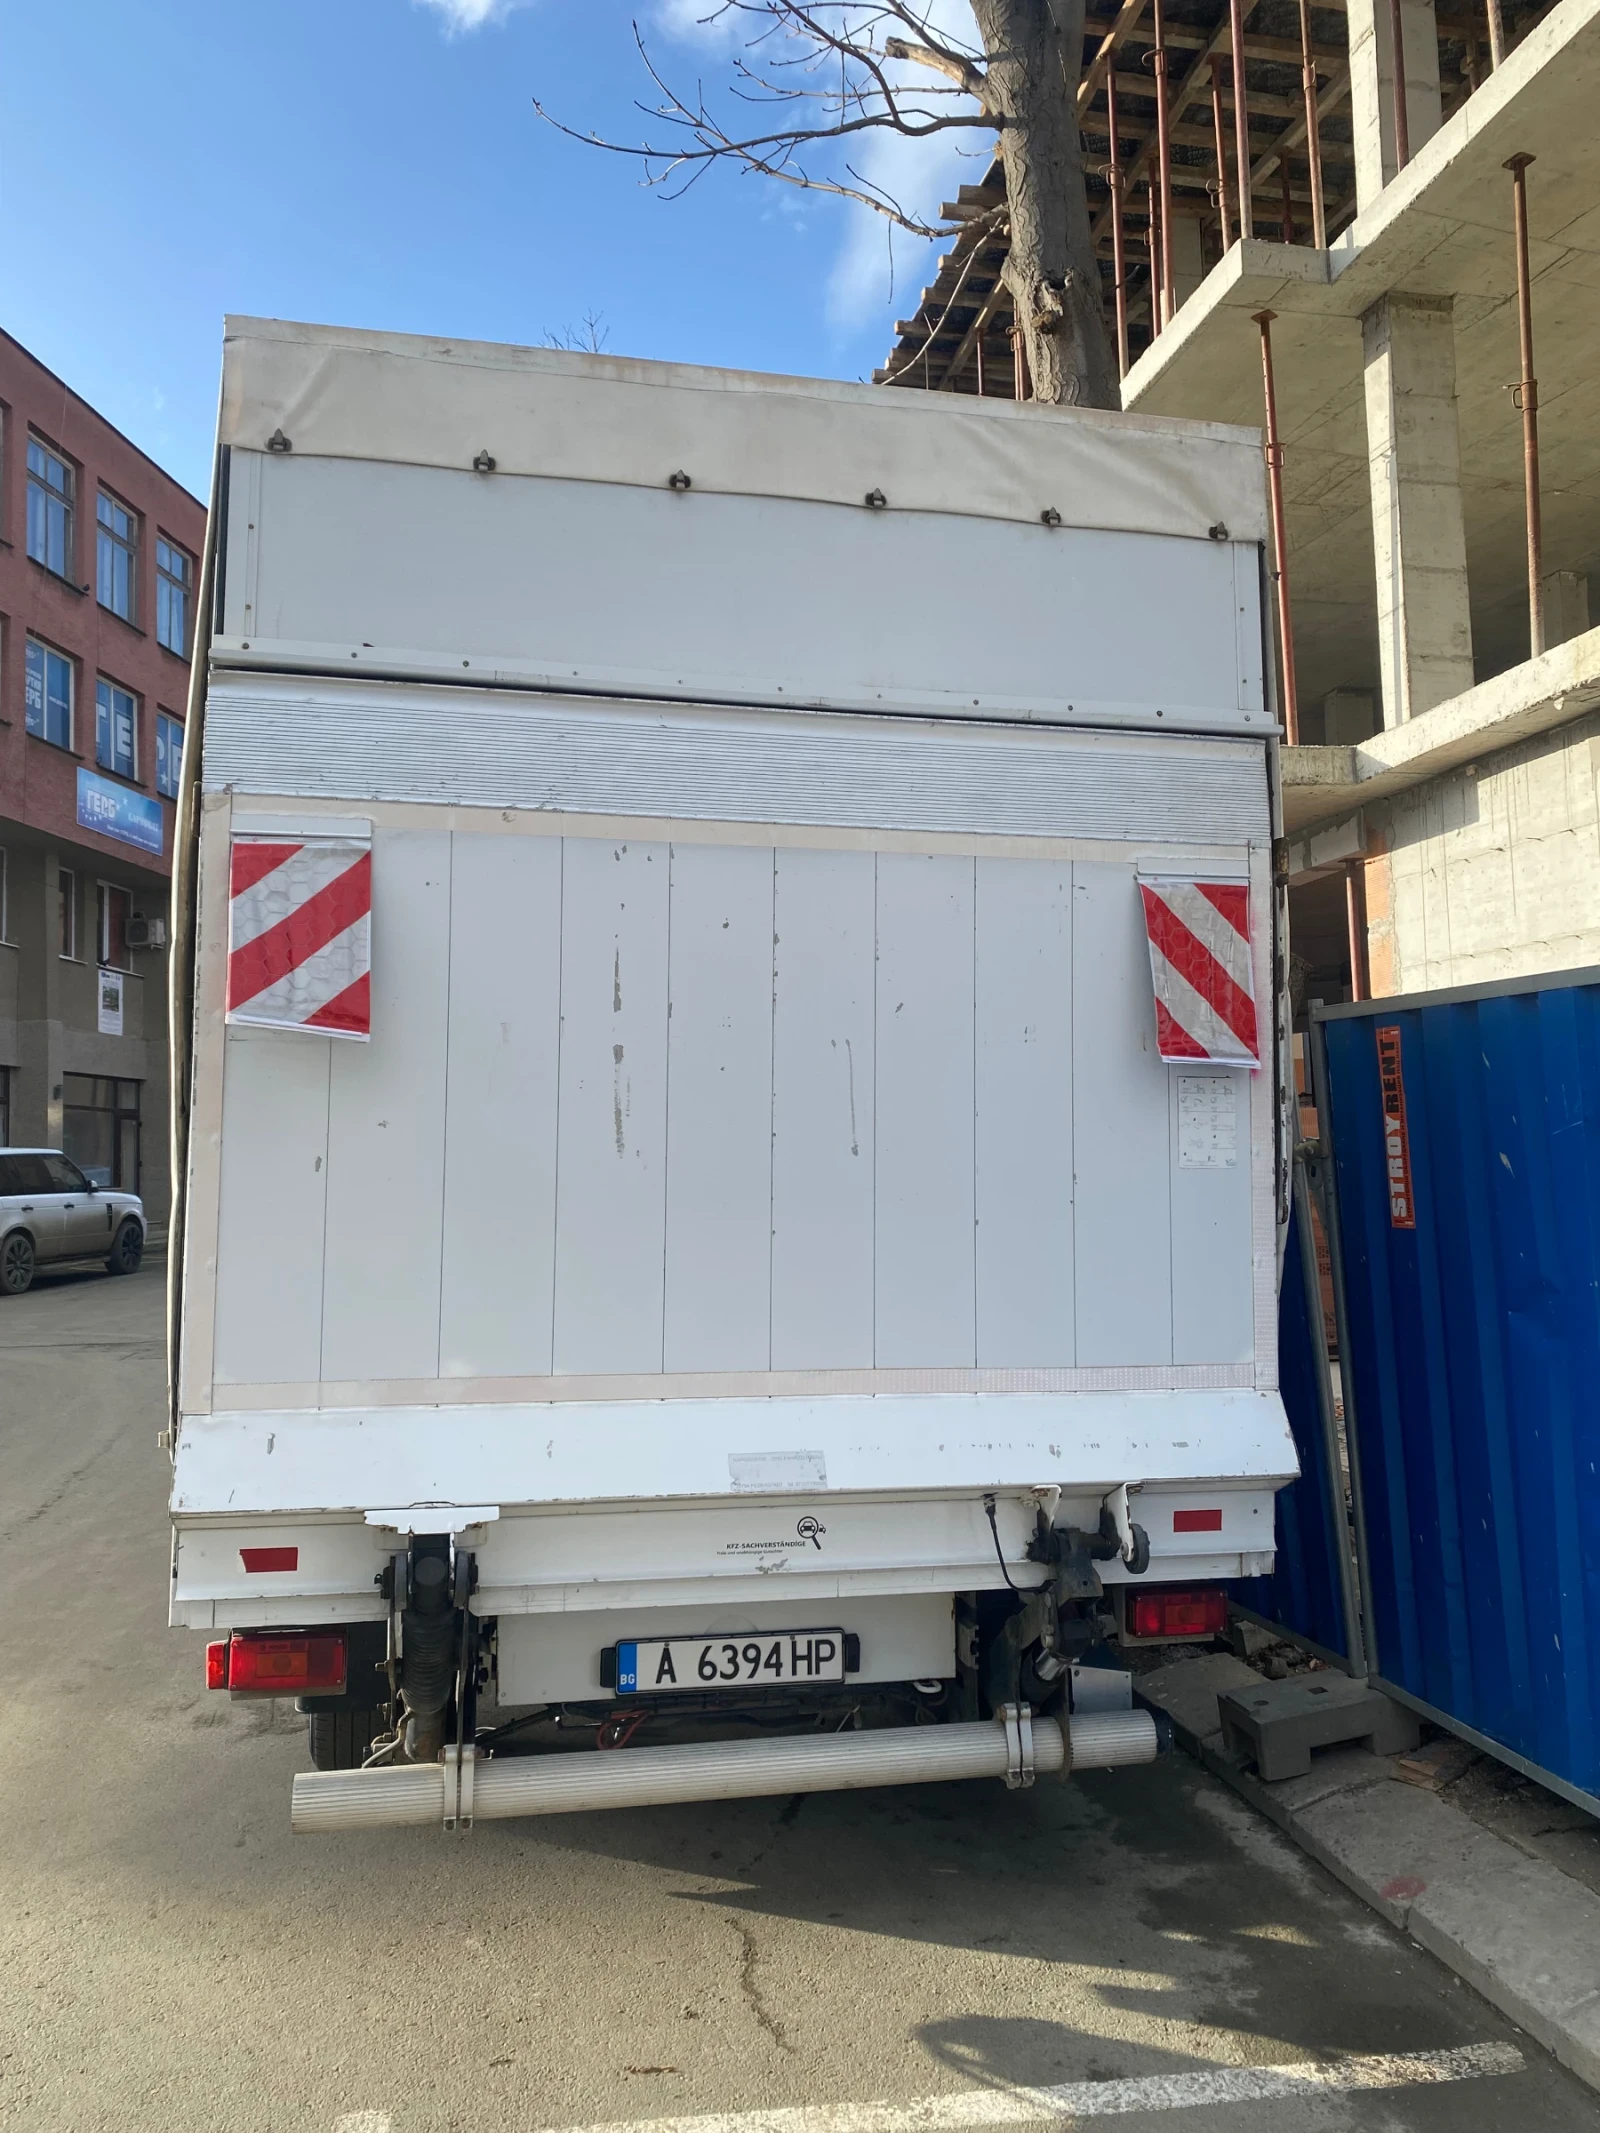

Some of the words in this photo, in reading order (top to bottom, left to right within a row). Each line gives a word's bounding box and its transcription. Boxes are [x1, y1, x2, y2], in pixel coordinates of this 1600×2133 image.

[26, 686, 41, 709] ЕРБ
[87, 790, 116, 819] ГЕРБ
[1379, 1039, 1408, 1218] STROYRENT
[620, 1674, 635, 1685] BG
[655, 1646, 677, 1684] A
[698, 1641, 783, 1681] 6394
